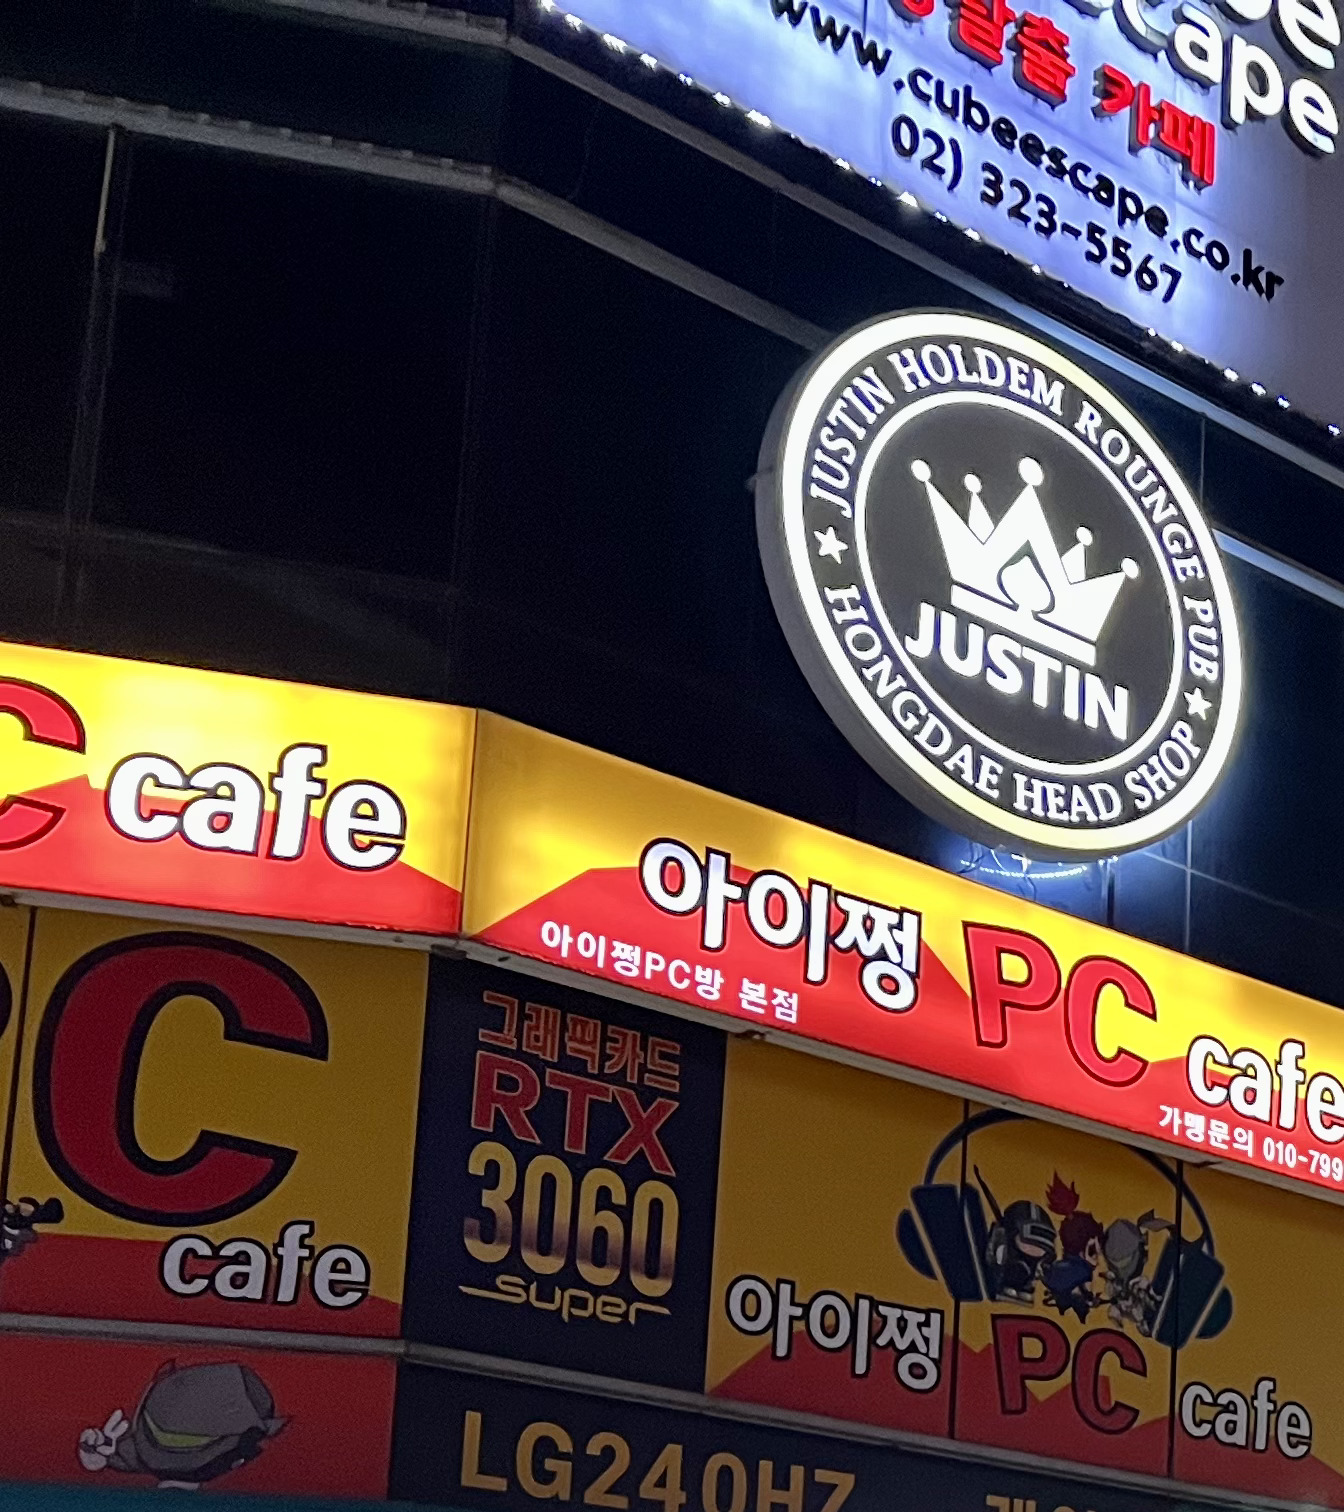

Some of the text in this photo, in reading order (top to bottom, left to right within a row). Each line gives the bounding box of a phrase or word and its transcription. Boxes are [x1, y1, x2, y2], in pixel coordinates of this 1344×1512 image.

[768, 0, 1284, 300] www.cubeescape.co.kr
[1066, 0, 1341, 152] cape
[1098, 58, 1219, 184] 카페
[811, 343, 1221, 684] JUSTIN HOLDEM ROUNGE PUB
[823, 584, 1203, 823] HONGDAE HEAD SHOP
[905, 601, 1130, 742] JUSTIN
[105, 743, 407, 871] cafe
[639, 837, 921, 1013] 아이쩡
[962, 919, 1159, 1088] PC
[737, 976, 800, 1024] 본점
[470, 1050, 680, 1177] RTX
[477, 989, 681, 1095] 그래픽카드
[0, 931, 371, 1308] C cafe
[1157, 1103, 1255, 1159] 가맹문의
[463, 1140, 679, 1298] 3060
[728, 1275, 944, 1392] 아이쩡
[990, 1313, 1147, 1434] PC
[1180, 1379, 1312, 1458] cafe
